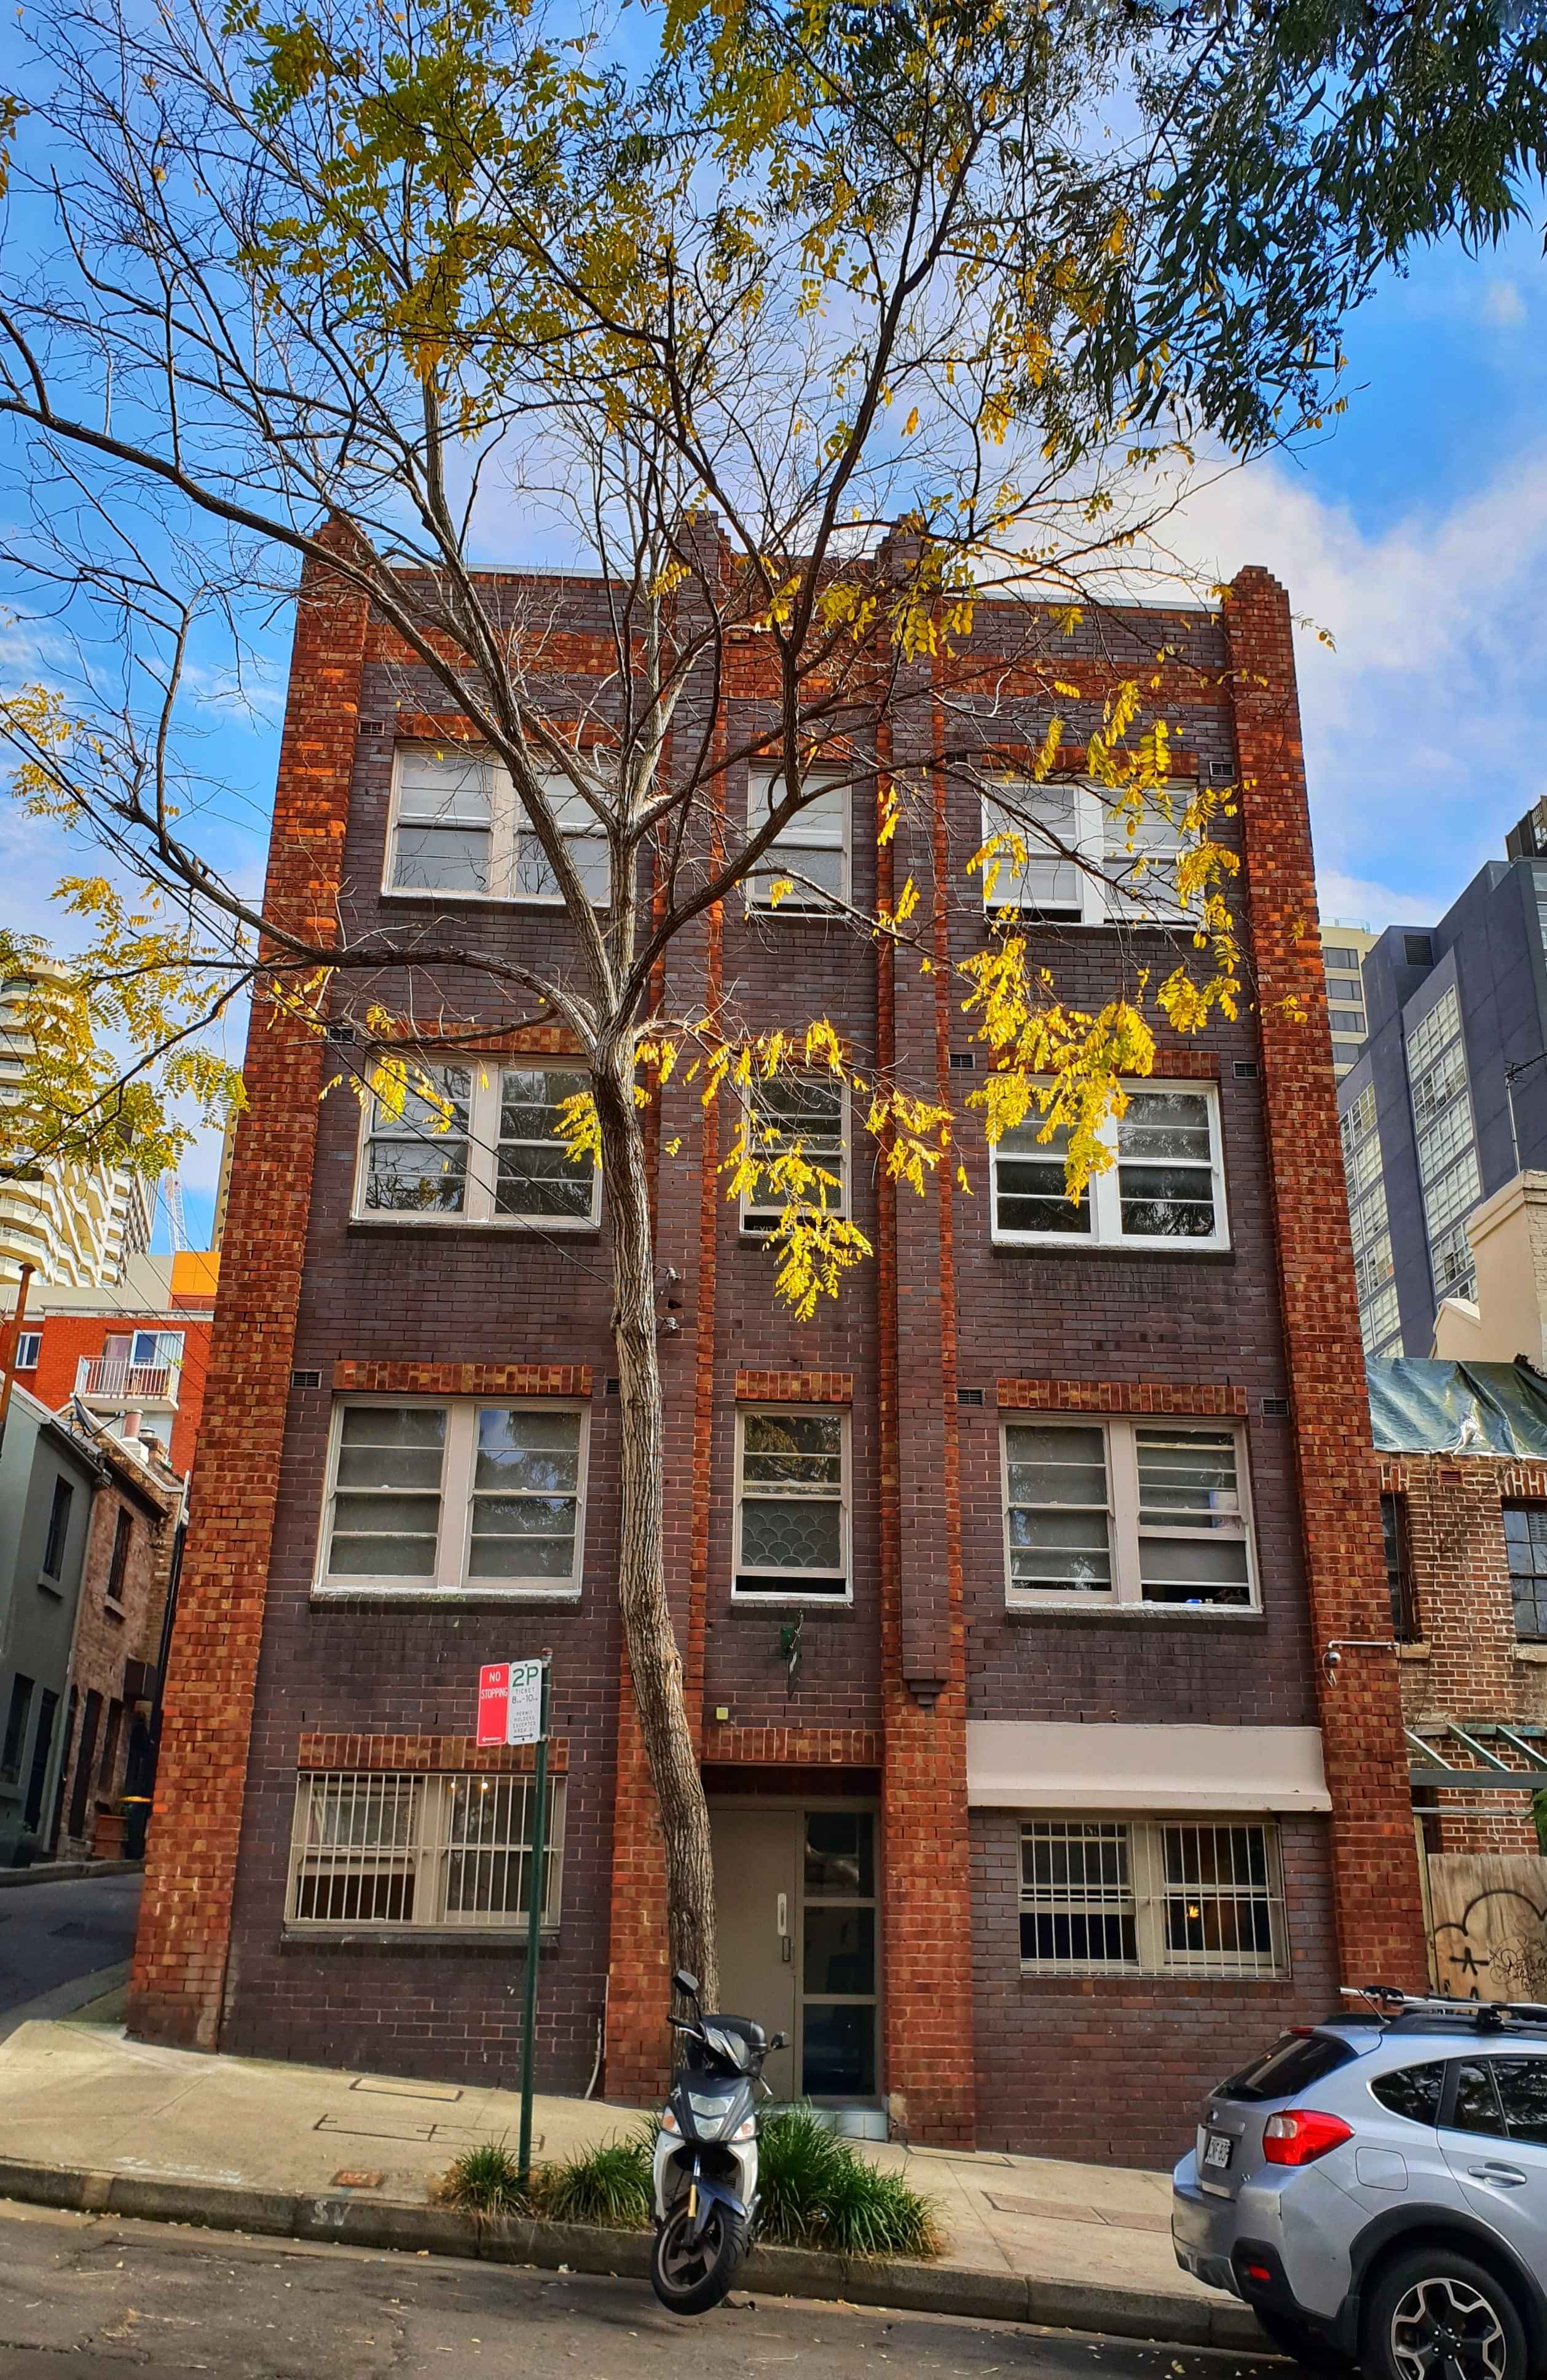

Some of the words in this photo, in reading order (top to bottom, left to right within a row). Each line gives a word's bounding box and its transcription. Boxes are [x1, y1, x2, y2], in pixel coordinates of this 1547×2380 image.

[489, 1671, 501, 1682] NO
[513, 1666, 538, 1687] 2P
[481, 1687, 508, 1700] STOPPING
